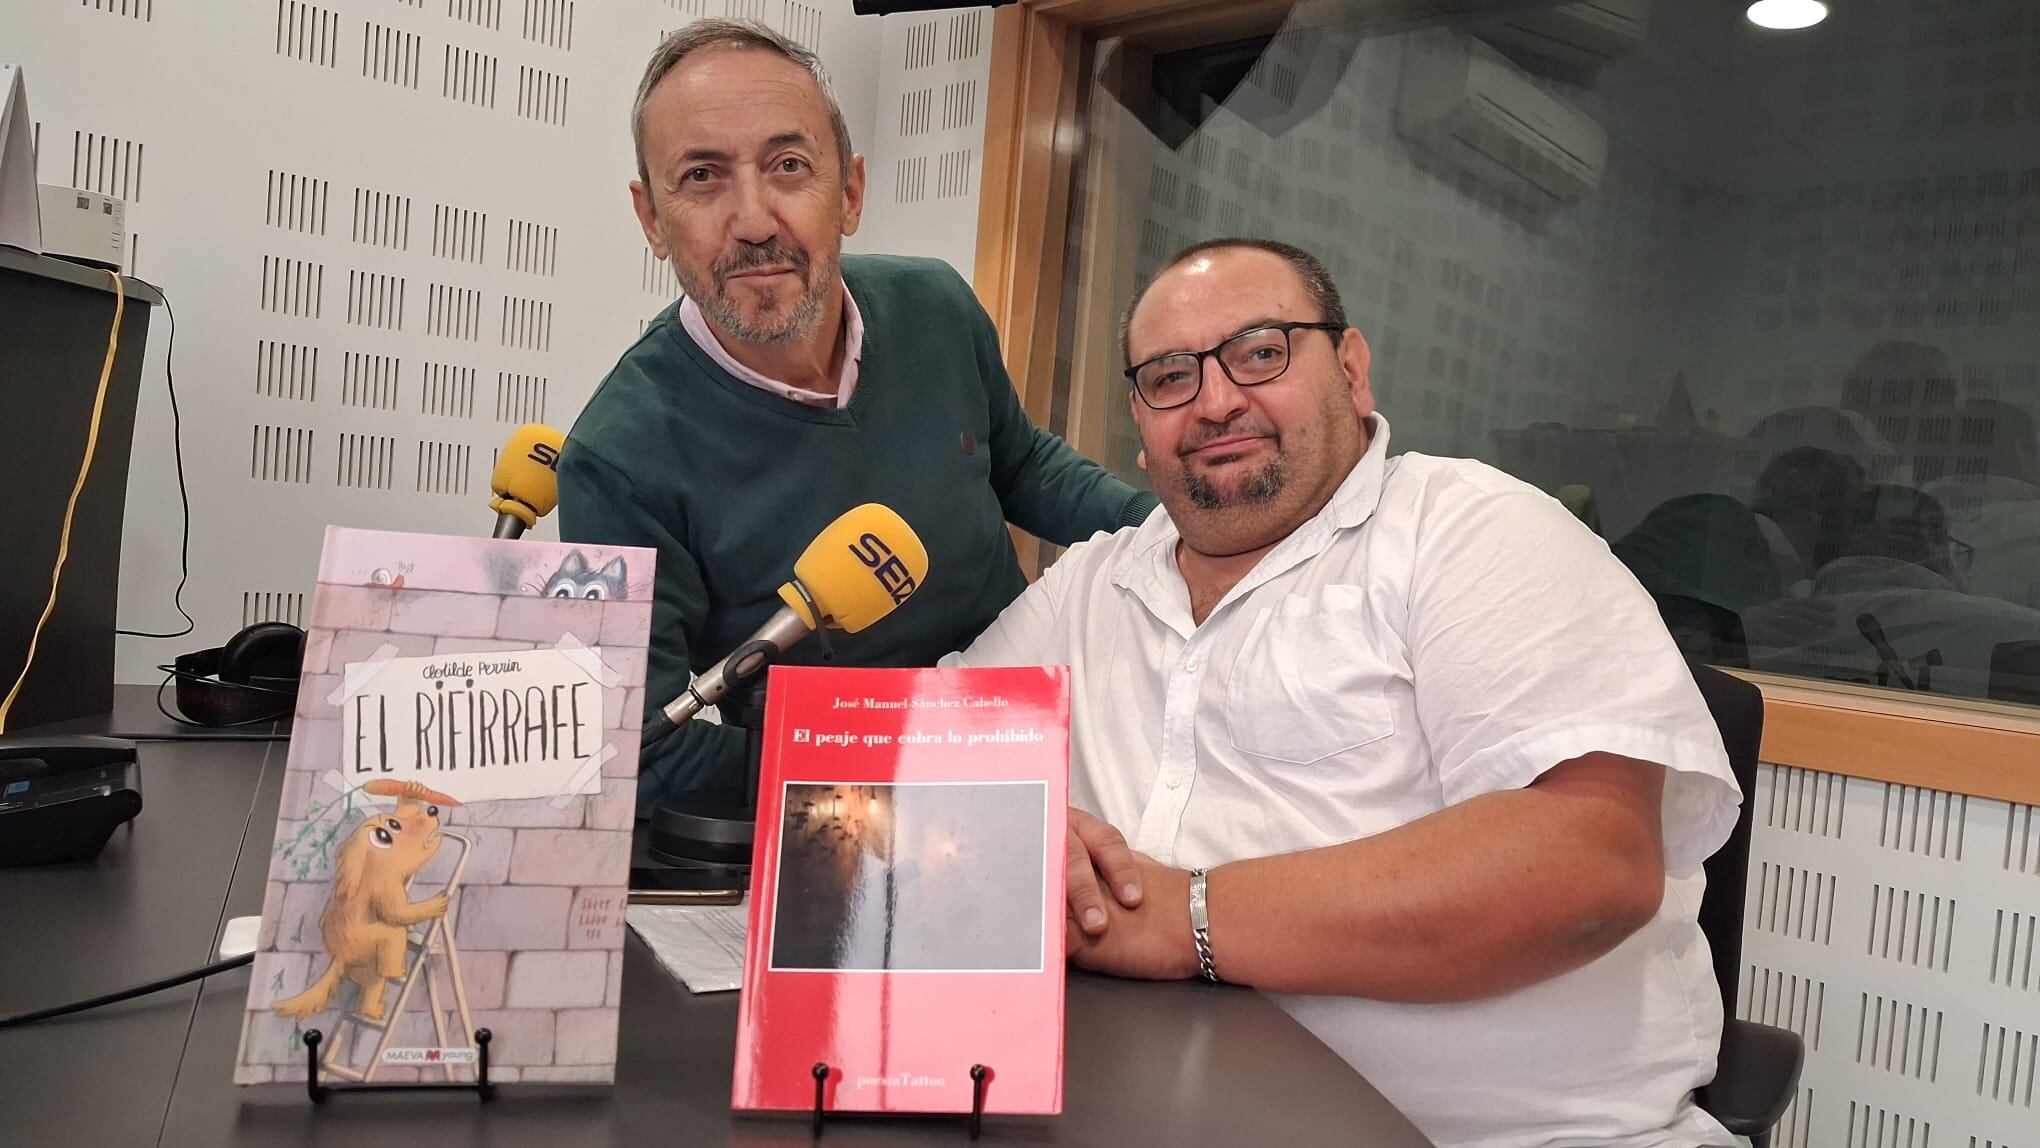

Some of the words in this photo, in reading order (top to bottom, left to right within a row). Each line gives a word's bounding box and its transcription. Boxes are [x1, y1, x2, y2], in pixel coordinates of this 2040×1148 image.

[422, 661, 473, 679] Clotilde
[478, 659, 522, 675] Perrin
[832, 697, 860, 710] José
[863, 698, 908, 709] Manuel
[911, 698, 960, 709] Sánchez
[963, 696, 1009, 708] Cabello
[355, 694, 394, 773] EL
[793, 729, 810, 743] El
[815, 732, 859, 747] peaje
[863, 733, 893, 747] que
[898, 732, 942, 744] cobra
[948, 731, 962, 744] lo
[968, 729, 1045, 746] prohibido
[386, 1051, 423, 1061] MAEVA
[442, 1051, 473, 1062] young
